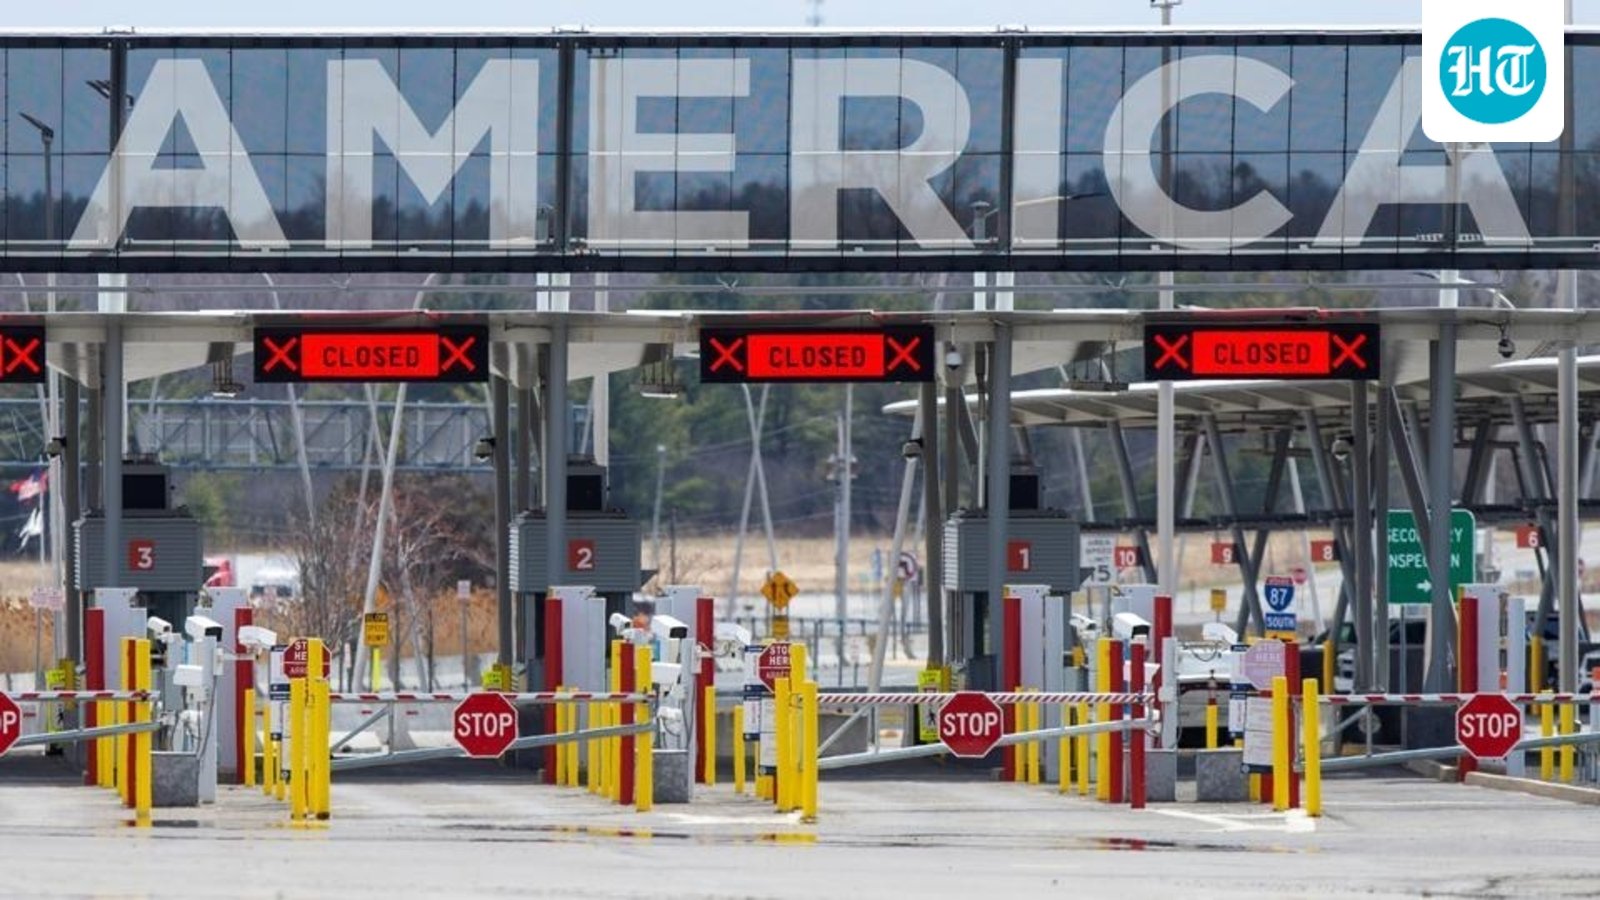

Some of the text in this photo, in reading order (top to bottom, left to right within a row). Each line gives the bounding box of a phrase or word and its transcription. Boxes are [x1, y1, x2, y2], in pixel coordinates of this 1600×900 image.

[67, 54, 1534, 250] AMERICA
[322, 345, 420, 368] CLOSED
[768, 345, 866, 368] CLOSED
[1213, 343, 1312, 366] CLOSED
[1528, 531, 1539, 547] 6
[138, 546, 153, 569] 3
[576, 547, 593, 569] 2
[1018, 548, 1031, 571] 1
[1119, 550, 1136, 566] 10
[1222, 548, 1232, 562] 9
[1323, 546, 1333, 560] 8
[1270, 588, 1288, 605] 87
[1266, 617, 1296, 628] SOUTH
[294, 641, 308, 651] ST
[769, 645, 788, 655] STO
[294, 652, 308, 660] HE
[769, 656, 789, 665] HER
[457, 712, 513, 737] STOP
[943, 712, 998, 736] STOP
[1461, 713, 1517, 738] STOP
